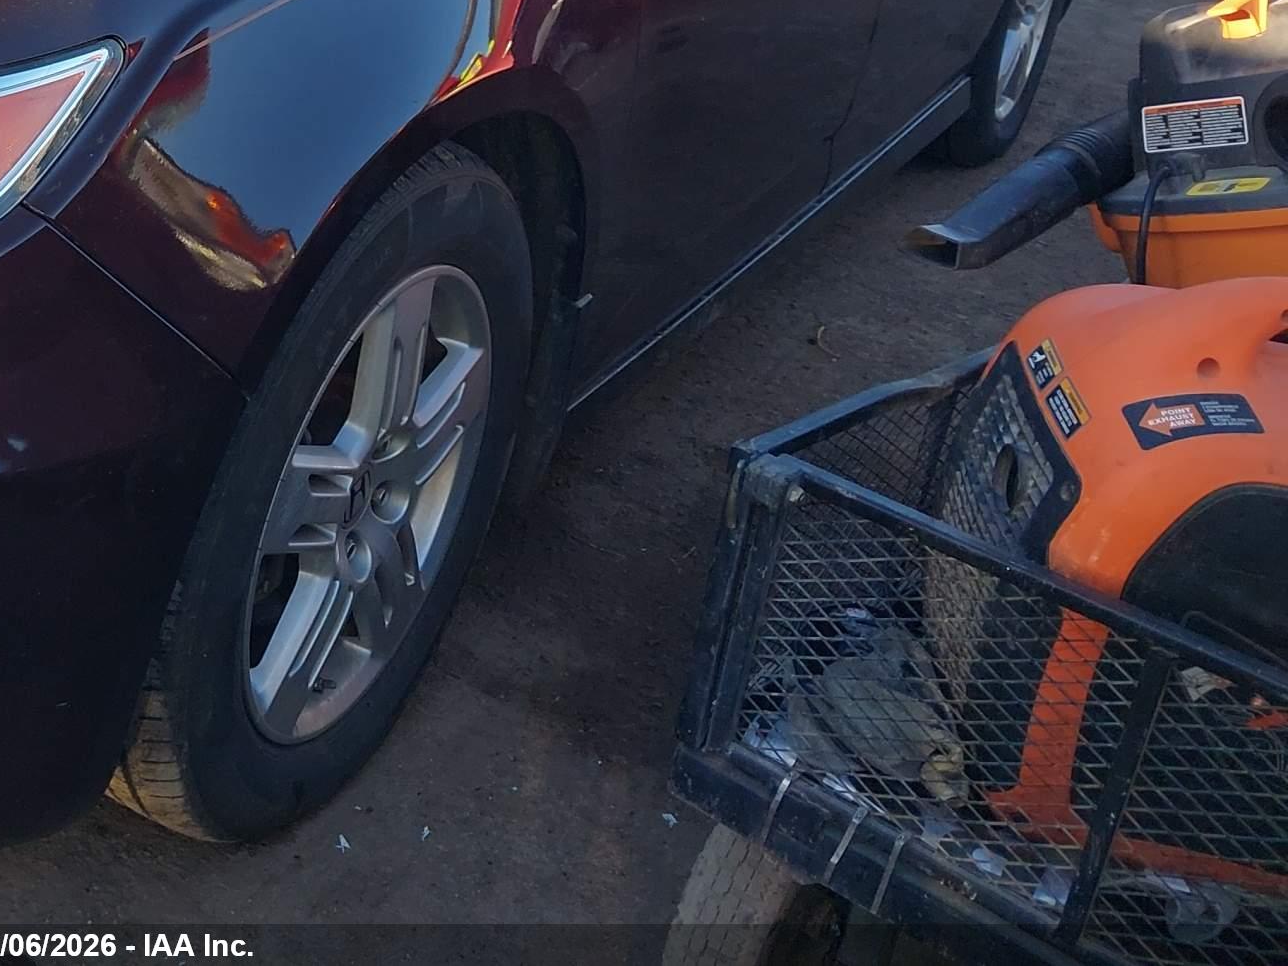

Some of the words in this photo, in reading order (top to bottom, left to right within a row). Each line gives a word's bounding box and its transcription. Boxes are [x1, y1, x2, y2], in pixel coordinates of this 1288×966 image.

[1160, 407, 1192, 417] POINT
[1147, 413, 1194, 427] EXHAUST
[1169, 419, 1197, 428] AWAY
